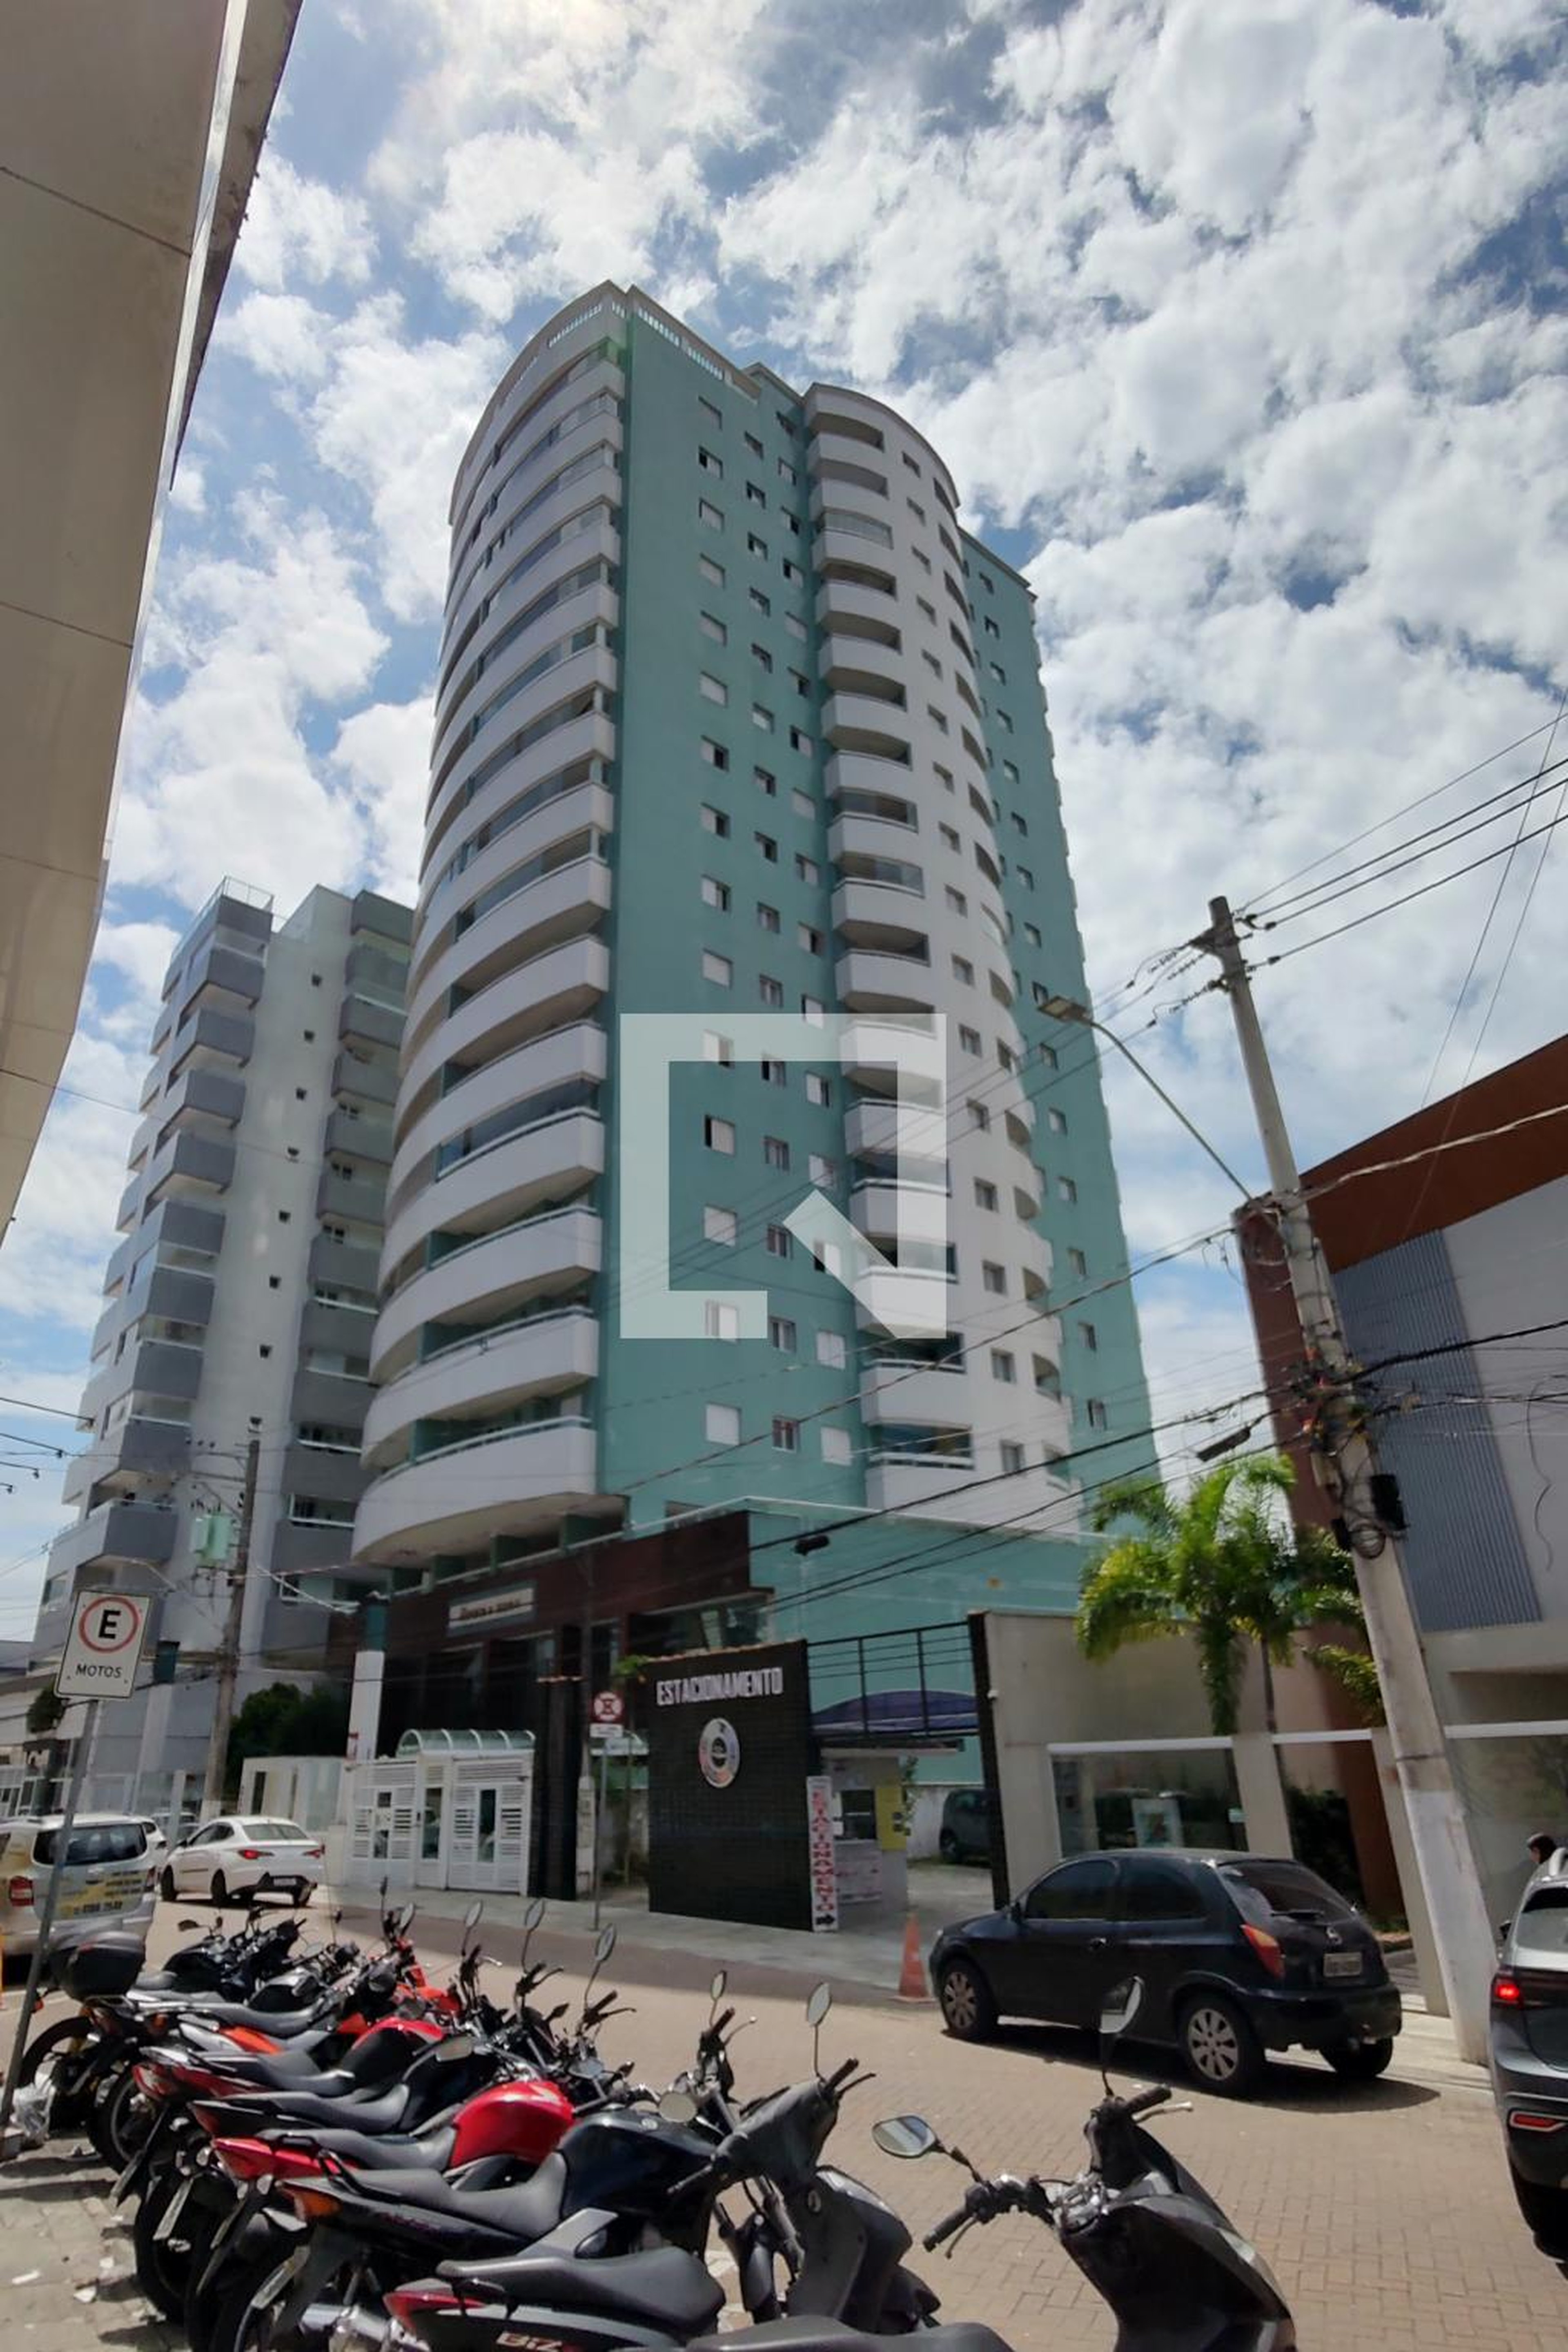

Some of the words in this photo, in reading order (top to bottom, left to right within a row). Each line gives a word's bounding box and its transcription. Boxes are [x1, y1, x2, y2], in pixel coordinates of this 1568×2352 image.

[98, 1610, 121, 1639] E
[76, 1664, 122, 1677] MOTOS
[657, 1667, 783, 1705] ESTACIONAMENTO
